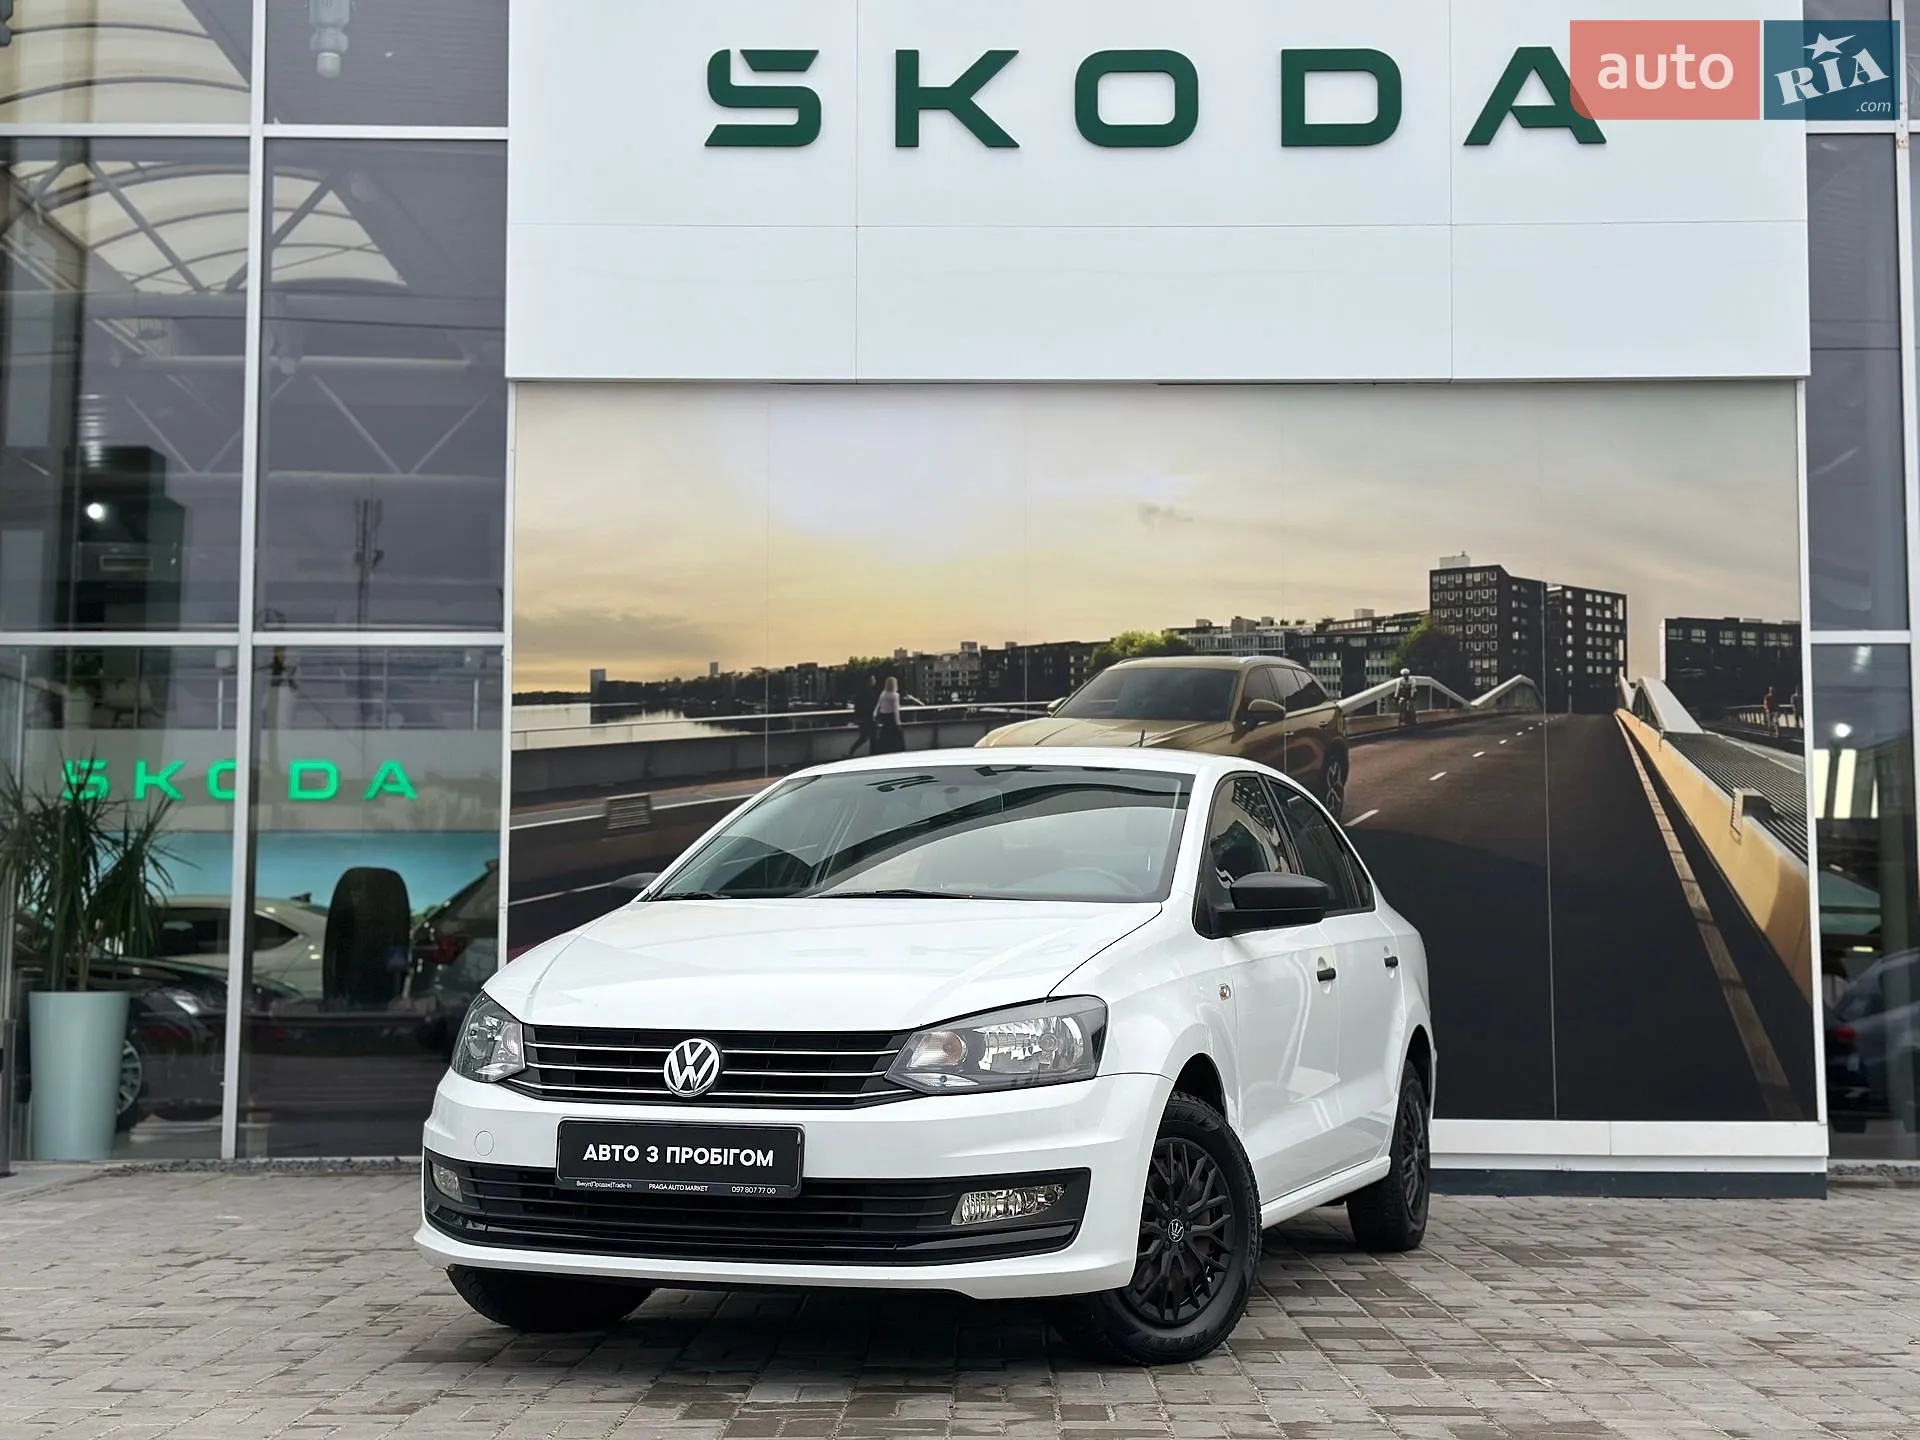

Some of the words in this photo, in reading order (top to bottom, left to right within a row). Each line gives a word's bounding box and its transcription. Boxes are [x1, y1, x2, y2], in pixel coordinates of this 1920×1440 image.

[705, 46, 1606, 148] SKODA
[583, 1143, 639, 1162] АВТО
[666, 1146, 773, 1167] ПРОБІГОМ
[648, 1183, 668, 1191] PRAGA
